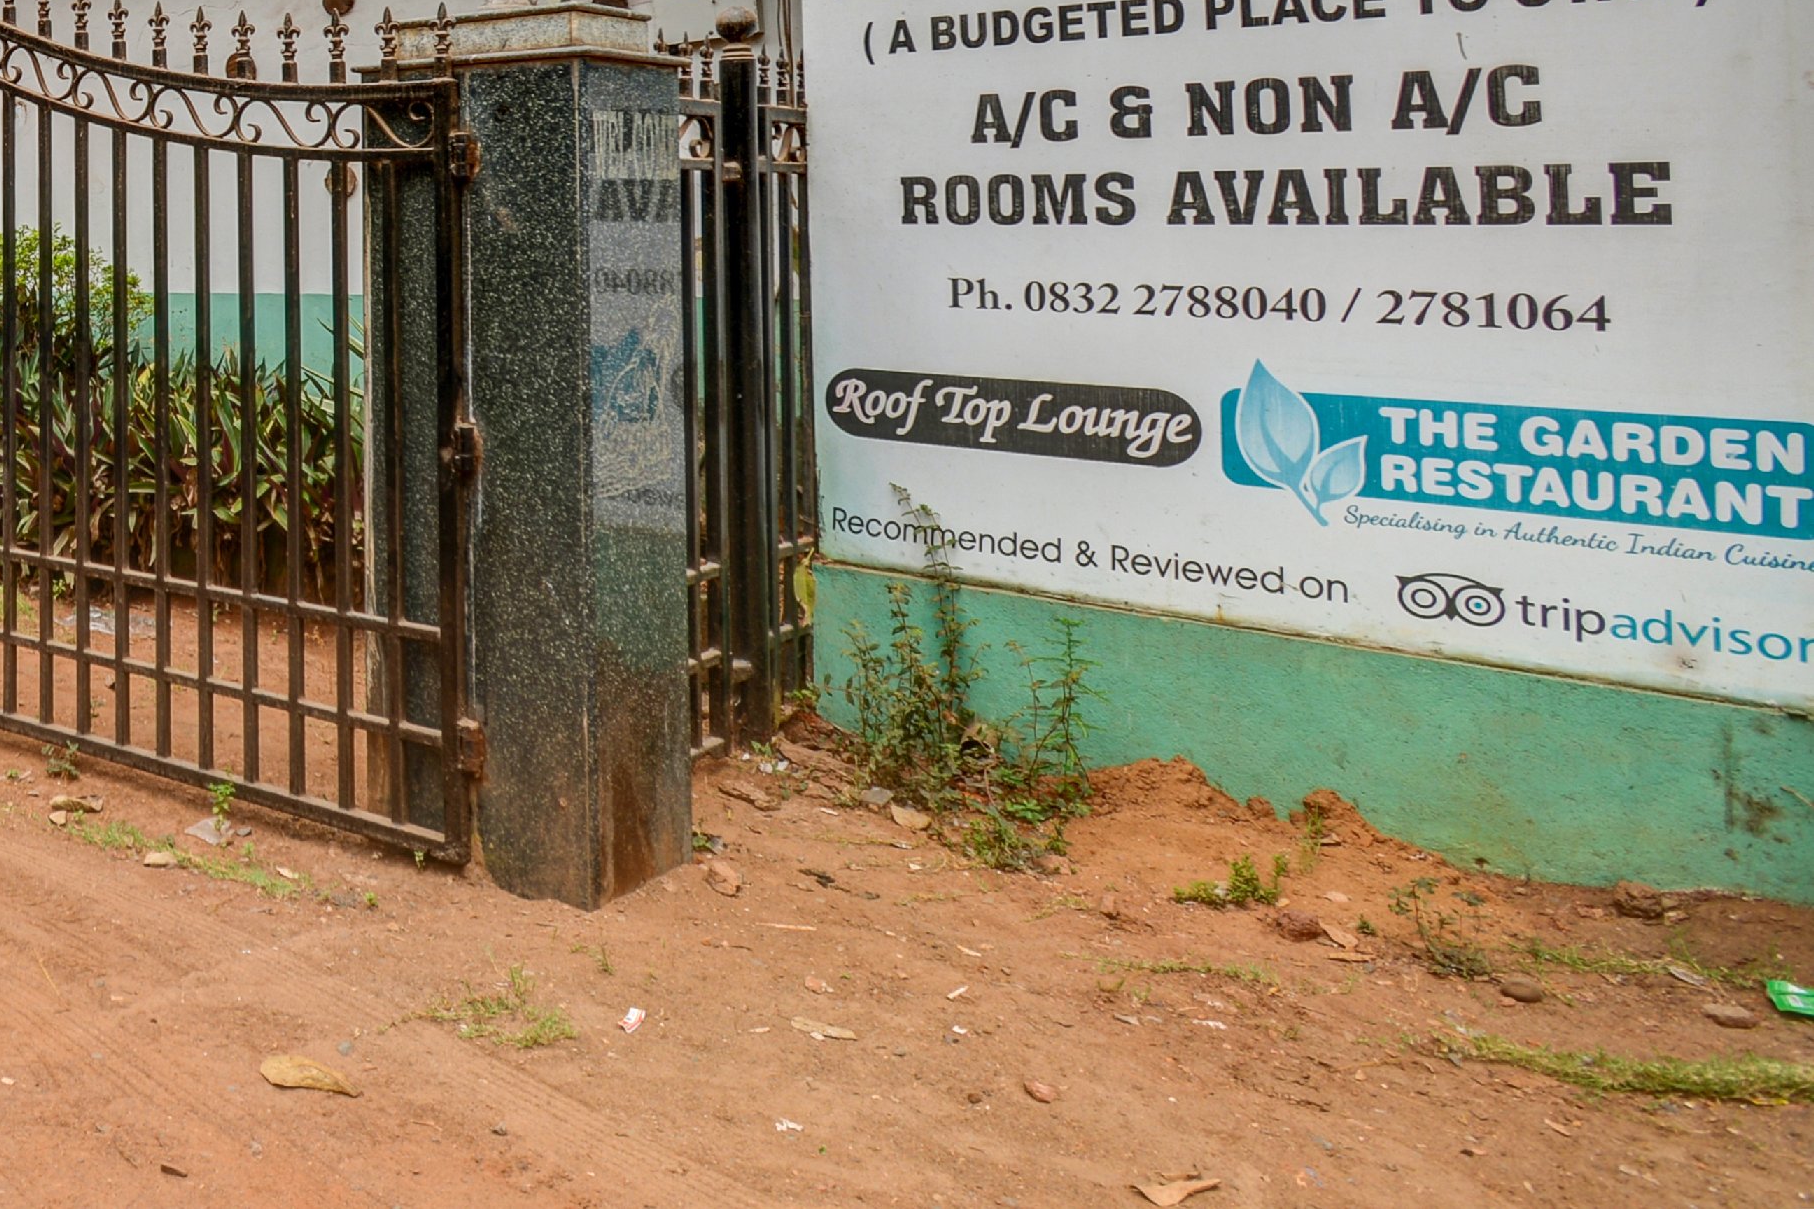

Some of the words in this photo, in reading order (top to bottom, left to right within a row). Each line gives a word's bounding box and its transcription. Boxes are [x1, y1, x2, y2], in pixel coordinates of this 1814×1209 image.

[971, 89, 1080, 149] A/C
[1109, 86, 1153, 139] &
[1185, 74, 1353, 136] NON
[1391, 65, 1542, 138] A/C
[900, 172, 1136, 225] ROOMS
[1166, 161, 1673, 226] AVAILABLE
[947, 276, 1012, 312] Ph.
[1024, 280, 1120, 316] 0832
[1135, 283, 1328, 324] 2788040
[1340, 286, 1360, 325] /
[1375, 288, 1612, 333] 2781064
[833, 378, 933, 435] Roof
[935, 385, 1010, 443] Top
[1018, 393, 1192, 458] Lounge
[1379, 407, 1498, 451] THE
[1519, 415, 1804, 475] GARDEN
[1380, 454, 1813, 528] RESTAURANT
[832, 507, 1061, 563] Recommended
[1075, 541, 1098, 567] &
[1110, 544, 1284, 595] Reviewed
[1299, 575, 1348, 603] on
[1343, 504, 1465, 539] Specialising
[1474, 521, 1497, 538] in
[1504, 522, 1618, 552] Authentic
[1625, 533, 1716, 561] Indian
[1515, 595, 1814, 663] tripadvisor
